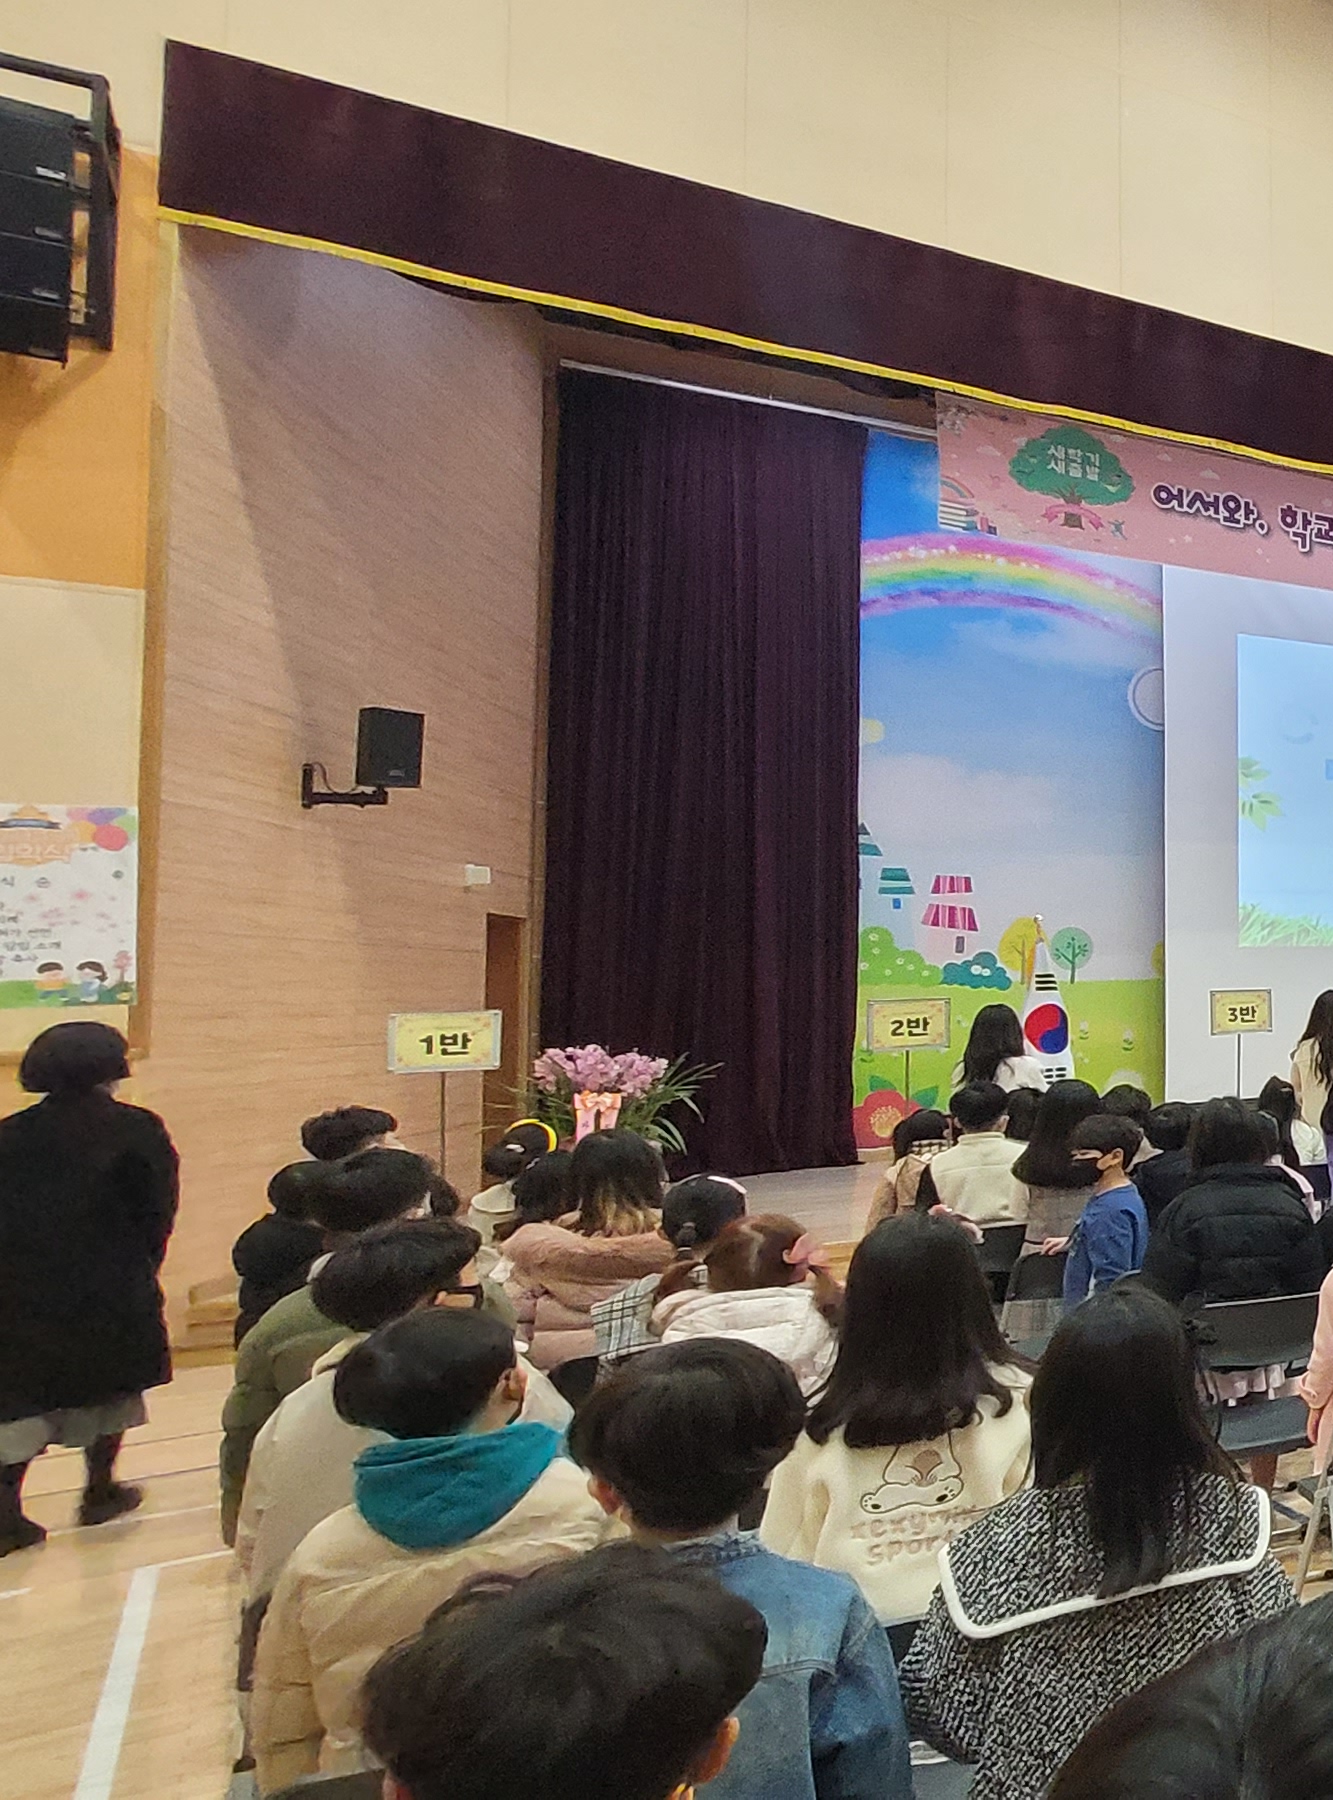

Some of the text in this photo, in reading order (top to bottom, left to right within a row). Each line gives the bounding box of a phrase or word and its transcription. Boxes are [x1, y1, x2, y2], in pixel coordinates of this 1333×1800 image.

[1228, 1005, 1257, 1023] 3반
[890, 1016, 930, 1037] 2반
[418, 1032, 472, 1056] 1반
